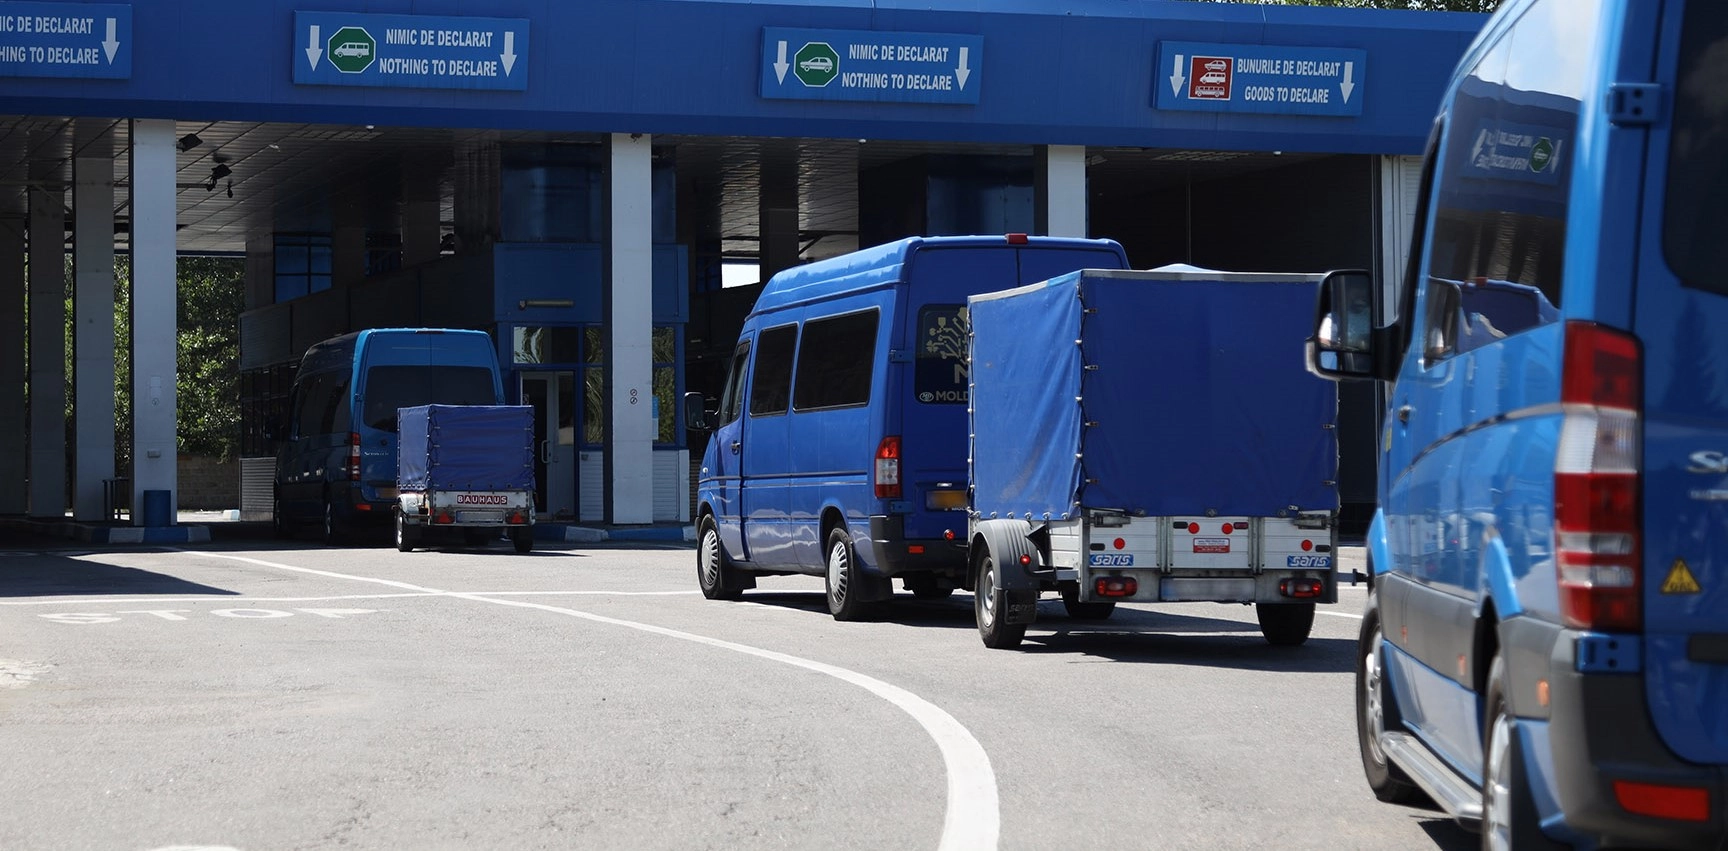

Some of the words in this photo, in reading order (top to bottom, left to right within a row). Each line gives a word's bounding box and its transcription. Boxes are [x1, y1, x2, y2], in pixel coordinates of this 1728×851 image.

[17, 16, 31, 32] DE
[35, 16, 93, 34] DECLARAT
[386, 29, 417, 45] NIMIC
[420, 29, 434, 45] DE
[437, 30, 493, 47] DECLARAT
[29, 46, 44, 63] TO
[47, 47, 99, 64] DECLARE
[849, 44, 878, 60] NIMIC
[881, 45, 894, 60] DE
[897, 45, 949, 62] DECLARAT
[379, 58, 428, 74] NOTHING
[431, 60, 446, 75] TO
[449, 60, 497, 76] DECLARE
[1237, 58, 1281, 74] BUNURILE
[1282, 60, 1294, 75] DE
[1297, 60, 1341, 76] DECLARAT
[842, 72, 888, 89] NOTHING
[891, 73, 904, 89] TO
[907, 74, 952, 90] DECLARE
[1244, 86, 1275, 101] GOODS
[1277, 87, 1288, 102] TO
[1290, 87, 1329, 103] DECLARE
[457, 494, 508, 504] BAUHAUS
[1094, 554, 1131, 566] saris
[1290, 556, 1328, 567] saris
[37, 607, 391, 624] STOP
